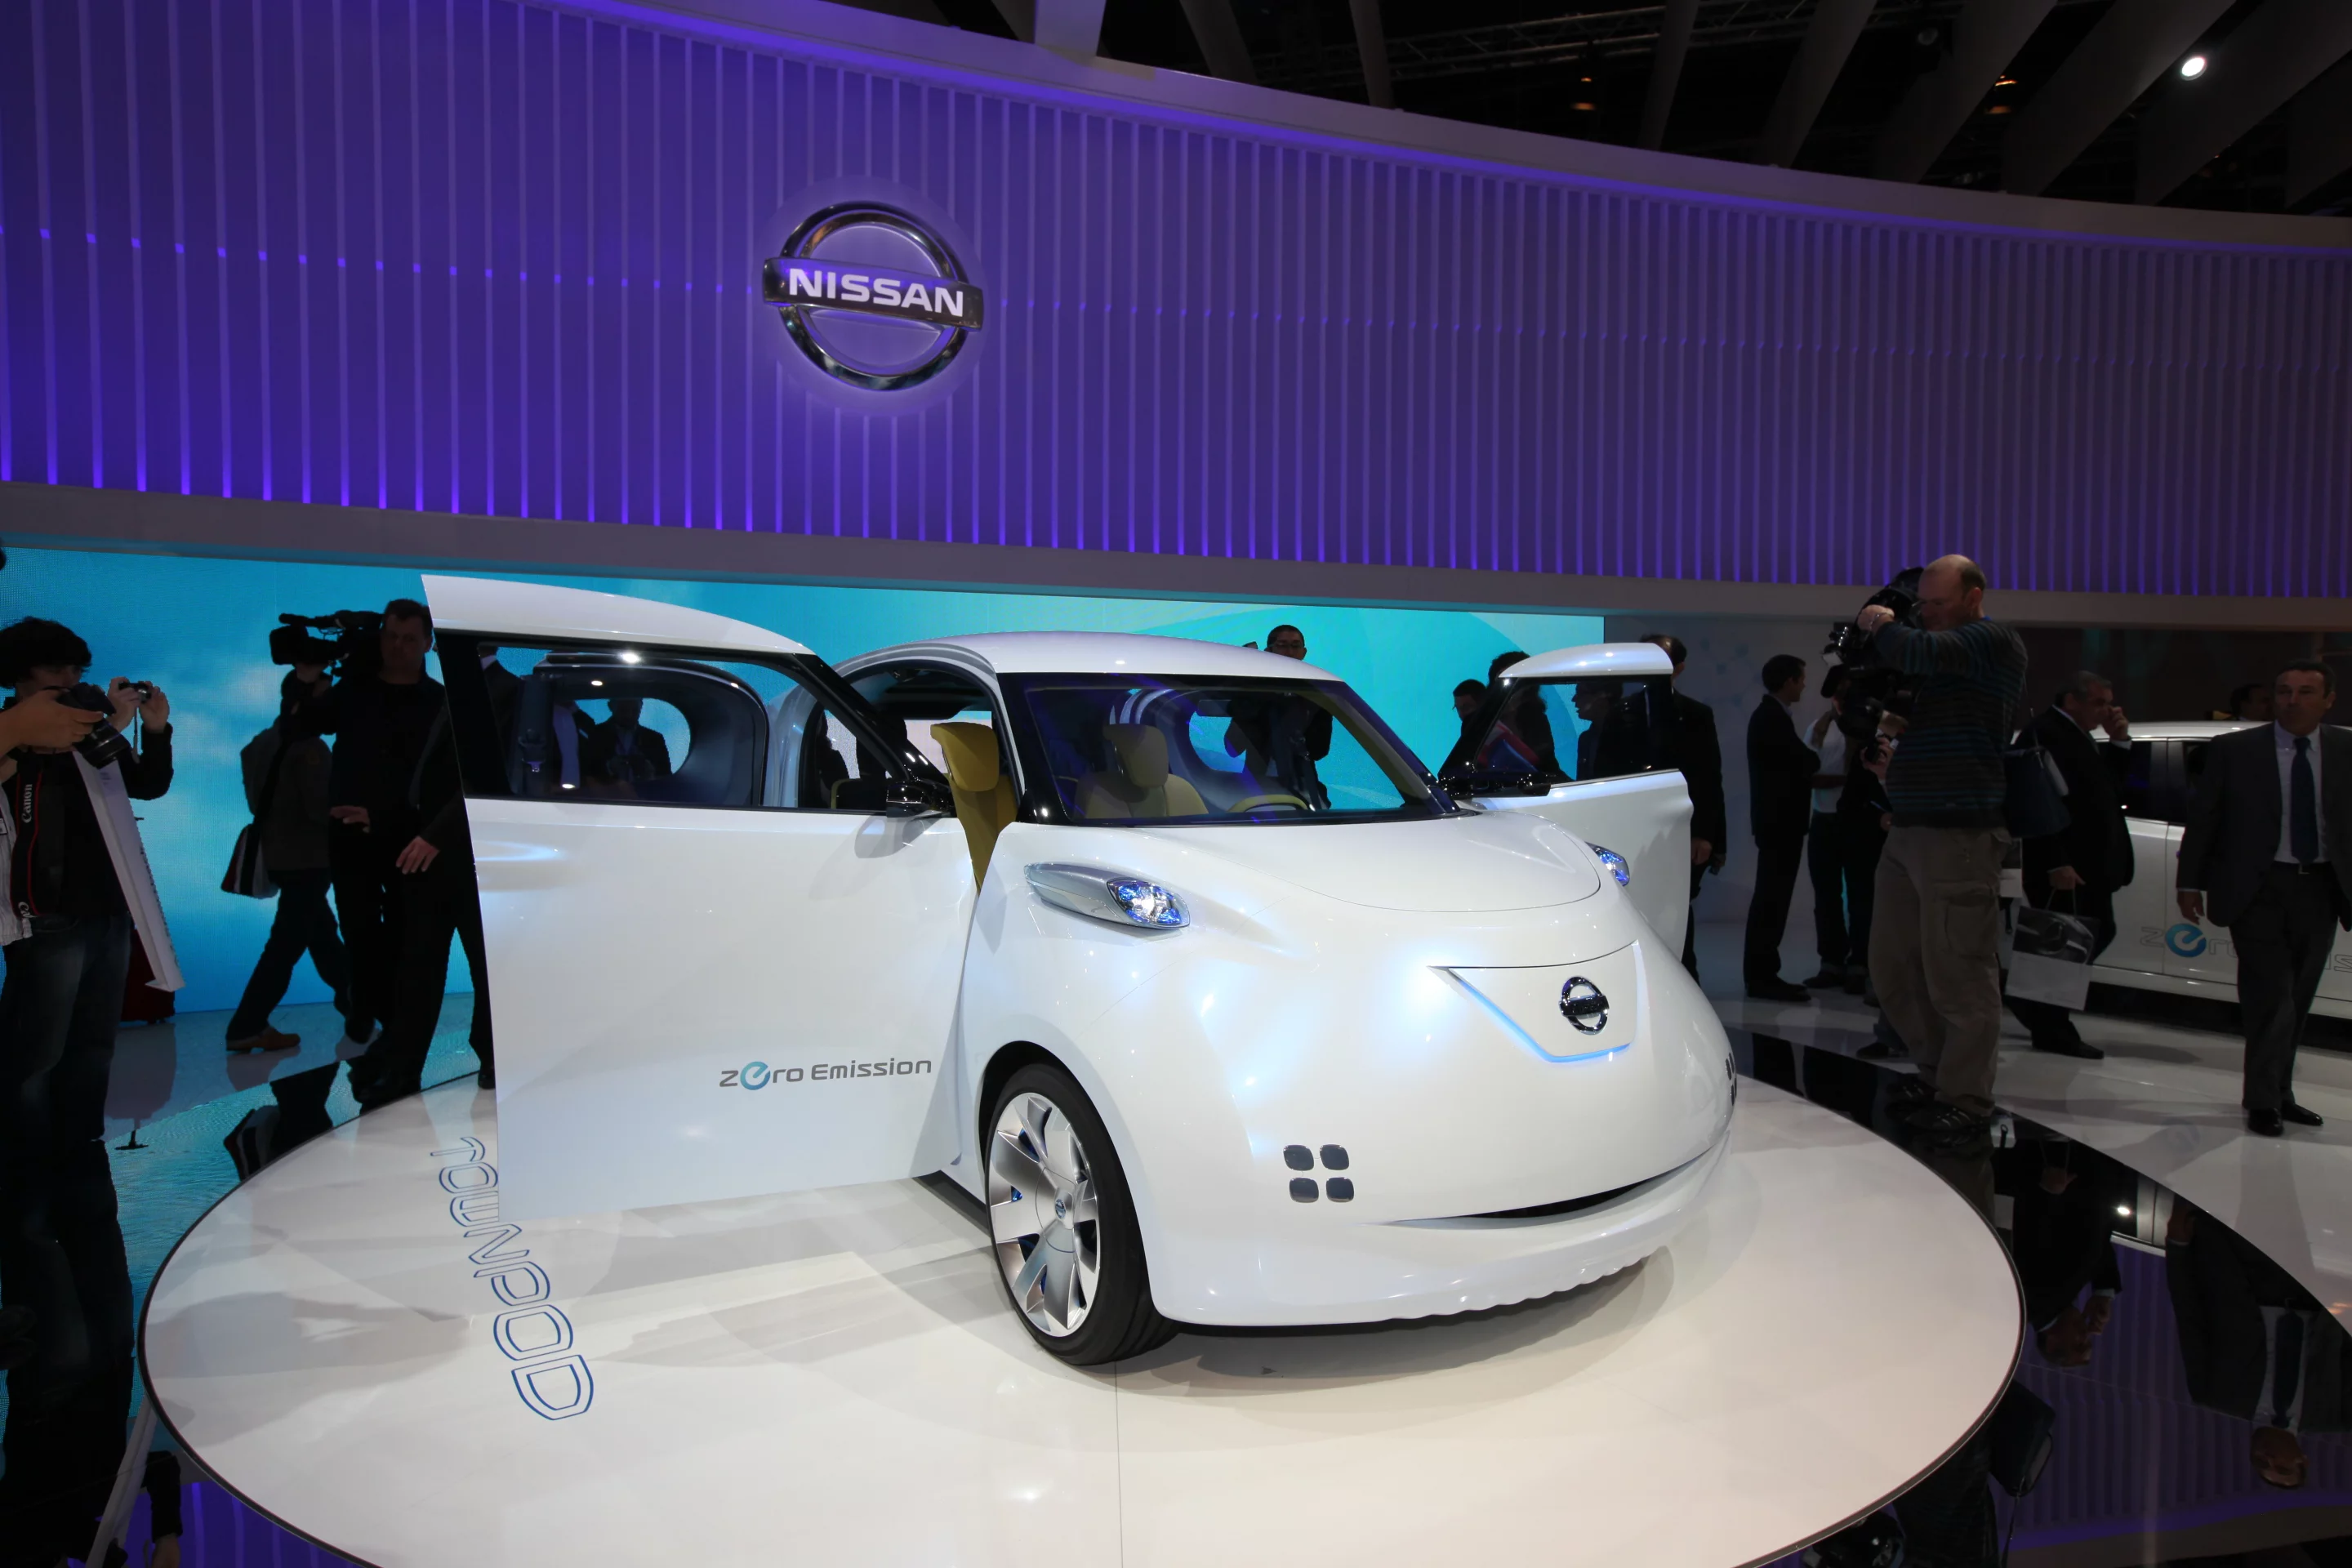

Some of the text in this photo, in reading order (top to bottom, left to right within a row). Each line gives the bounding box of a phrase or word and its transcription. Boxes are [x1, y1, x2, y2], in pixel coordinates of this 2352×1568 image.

[789, 268, 964, 317] NISSAN
[21, 783, 33, 823] Canon
[2140, 923, 2238, 957] zer
[811, 1058, 932, 1080] Emission
